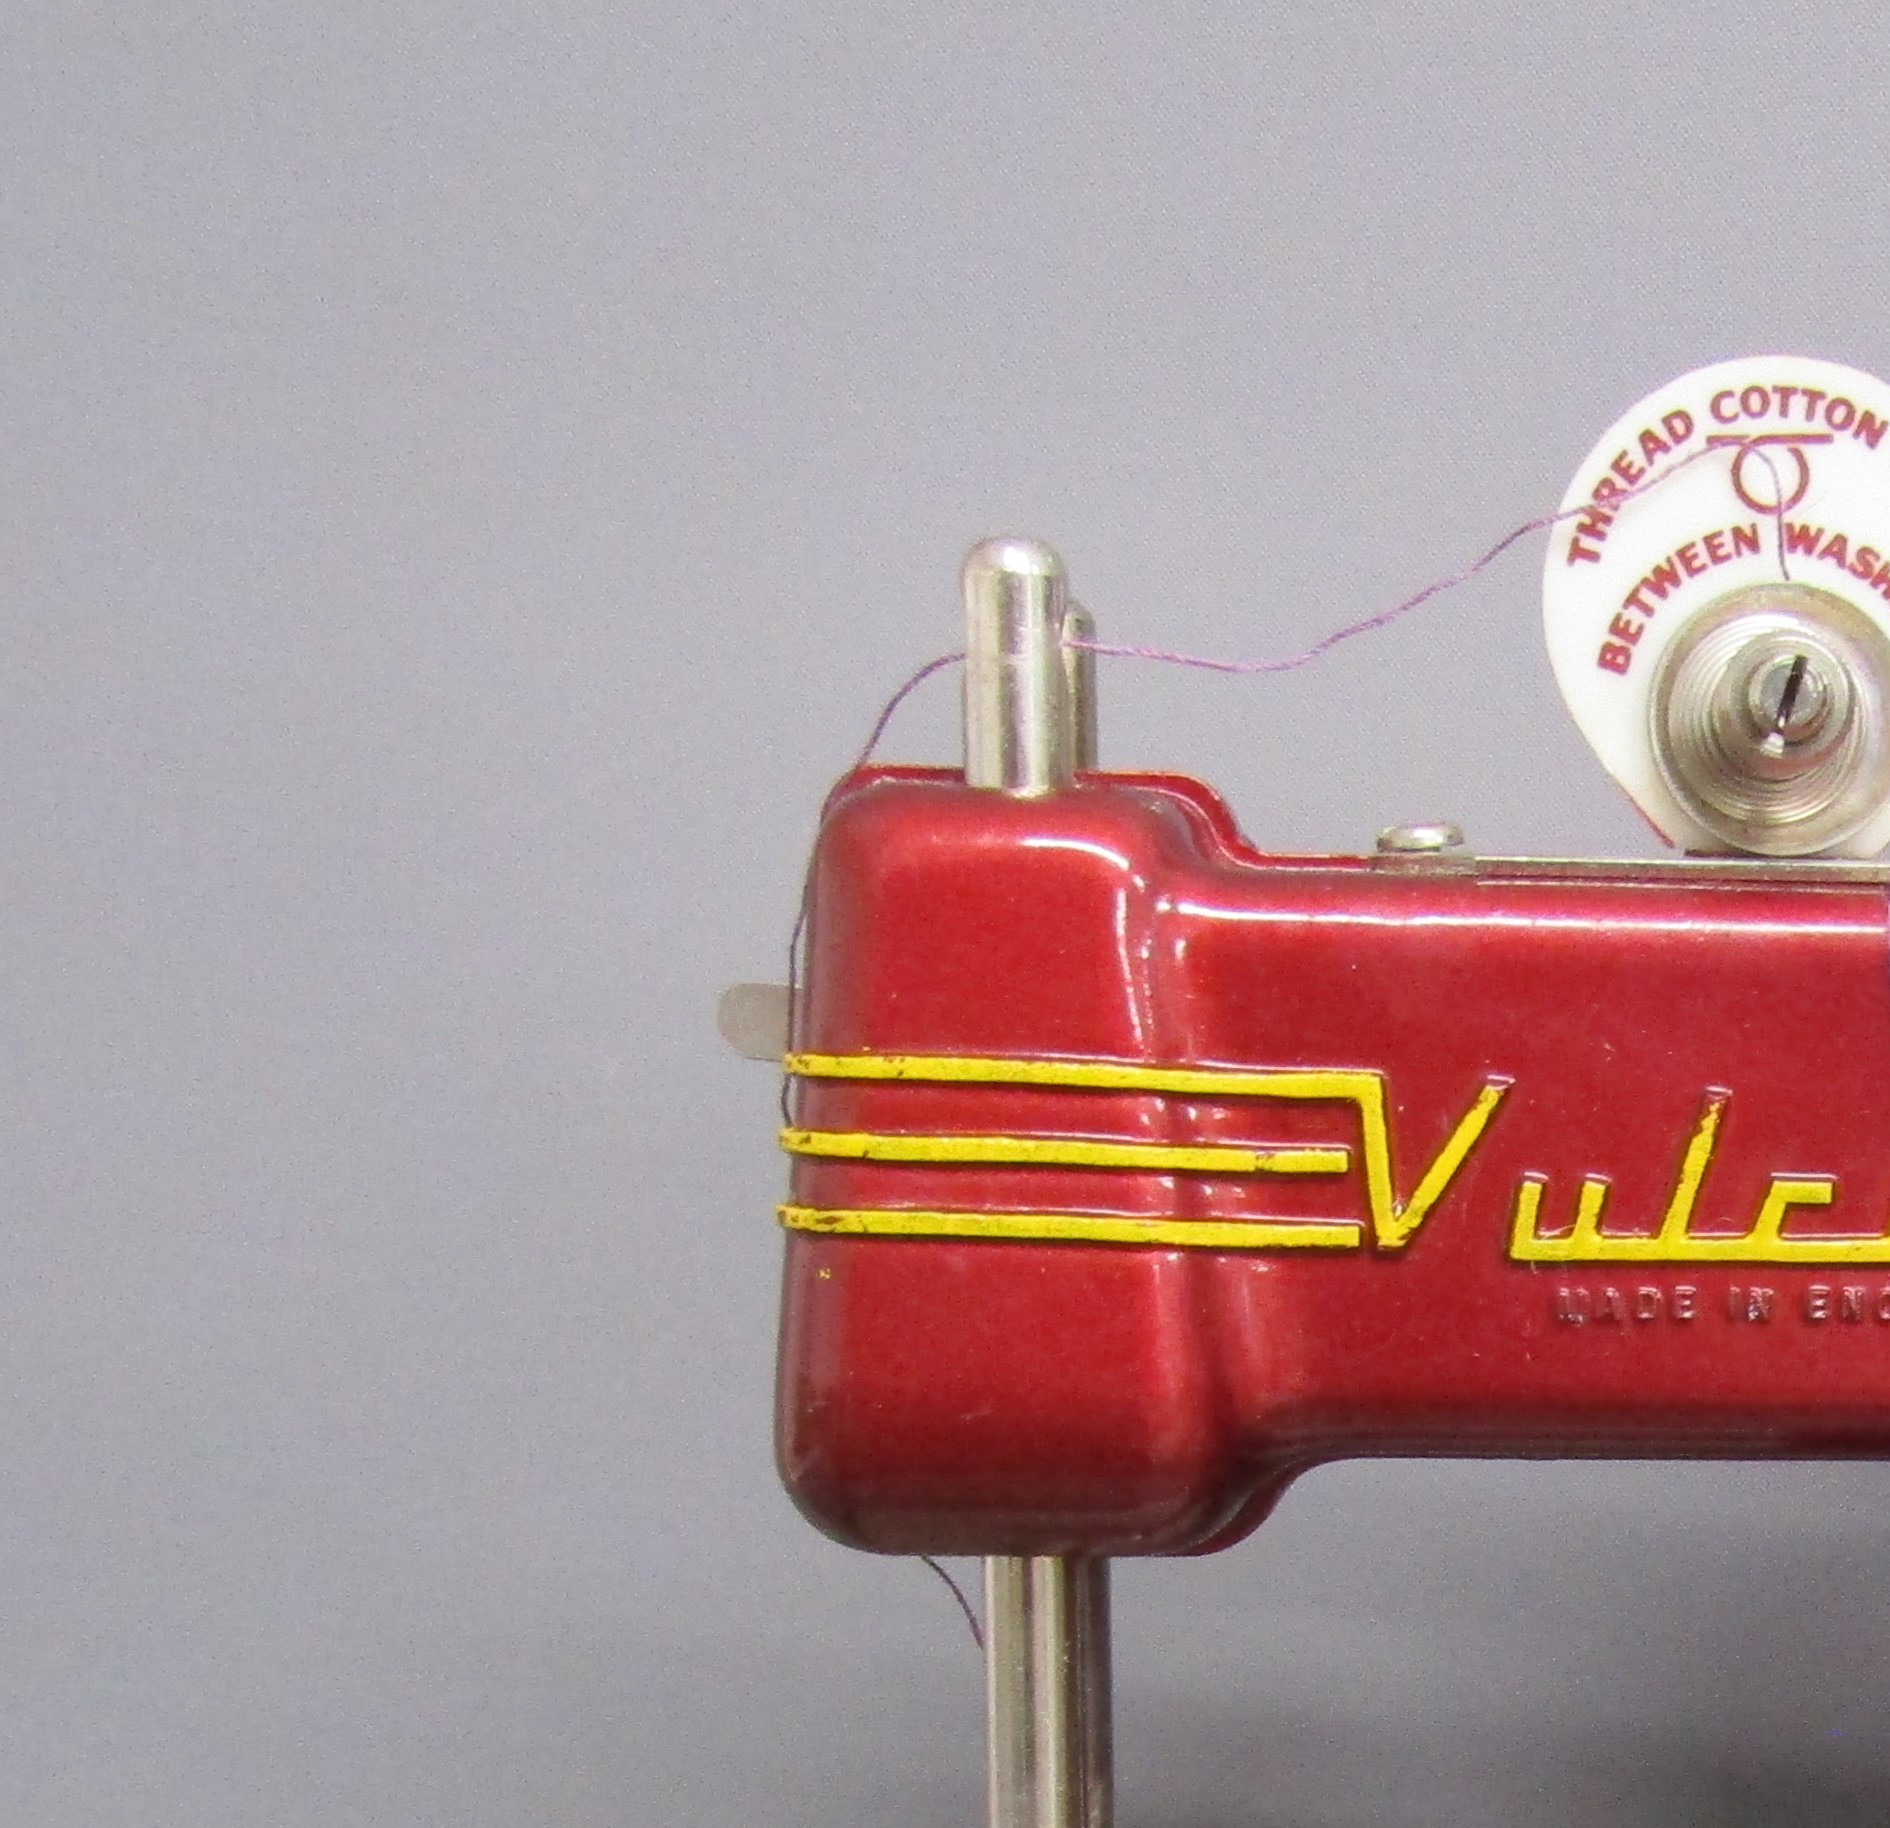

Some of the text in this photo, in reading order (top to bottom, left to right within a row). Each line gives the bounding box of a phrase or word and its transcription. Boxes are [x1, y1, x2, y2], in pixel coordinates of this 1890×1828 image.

[1567, 409, 1694, 566] THREAD
[1710, 386, 1888, 449] COTTON
[1597, 523, 1760, 676] BETWEEN
[1556, 1285, 1697, 1325] MADE
[1729, 1285, 1775, 1323] IN
